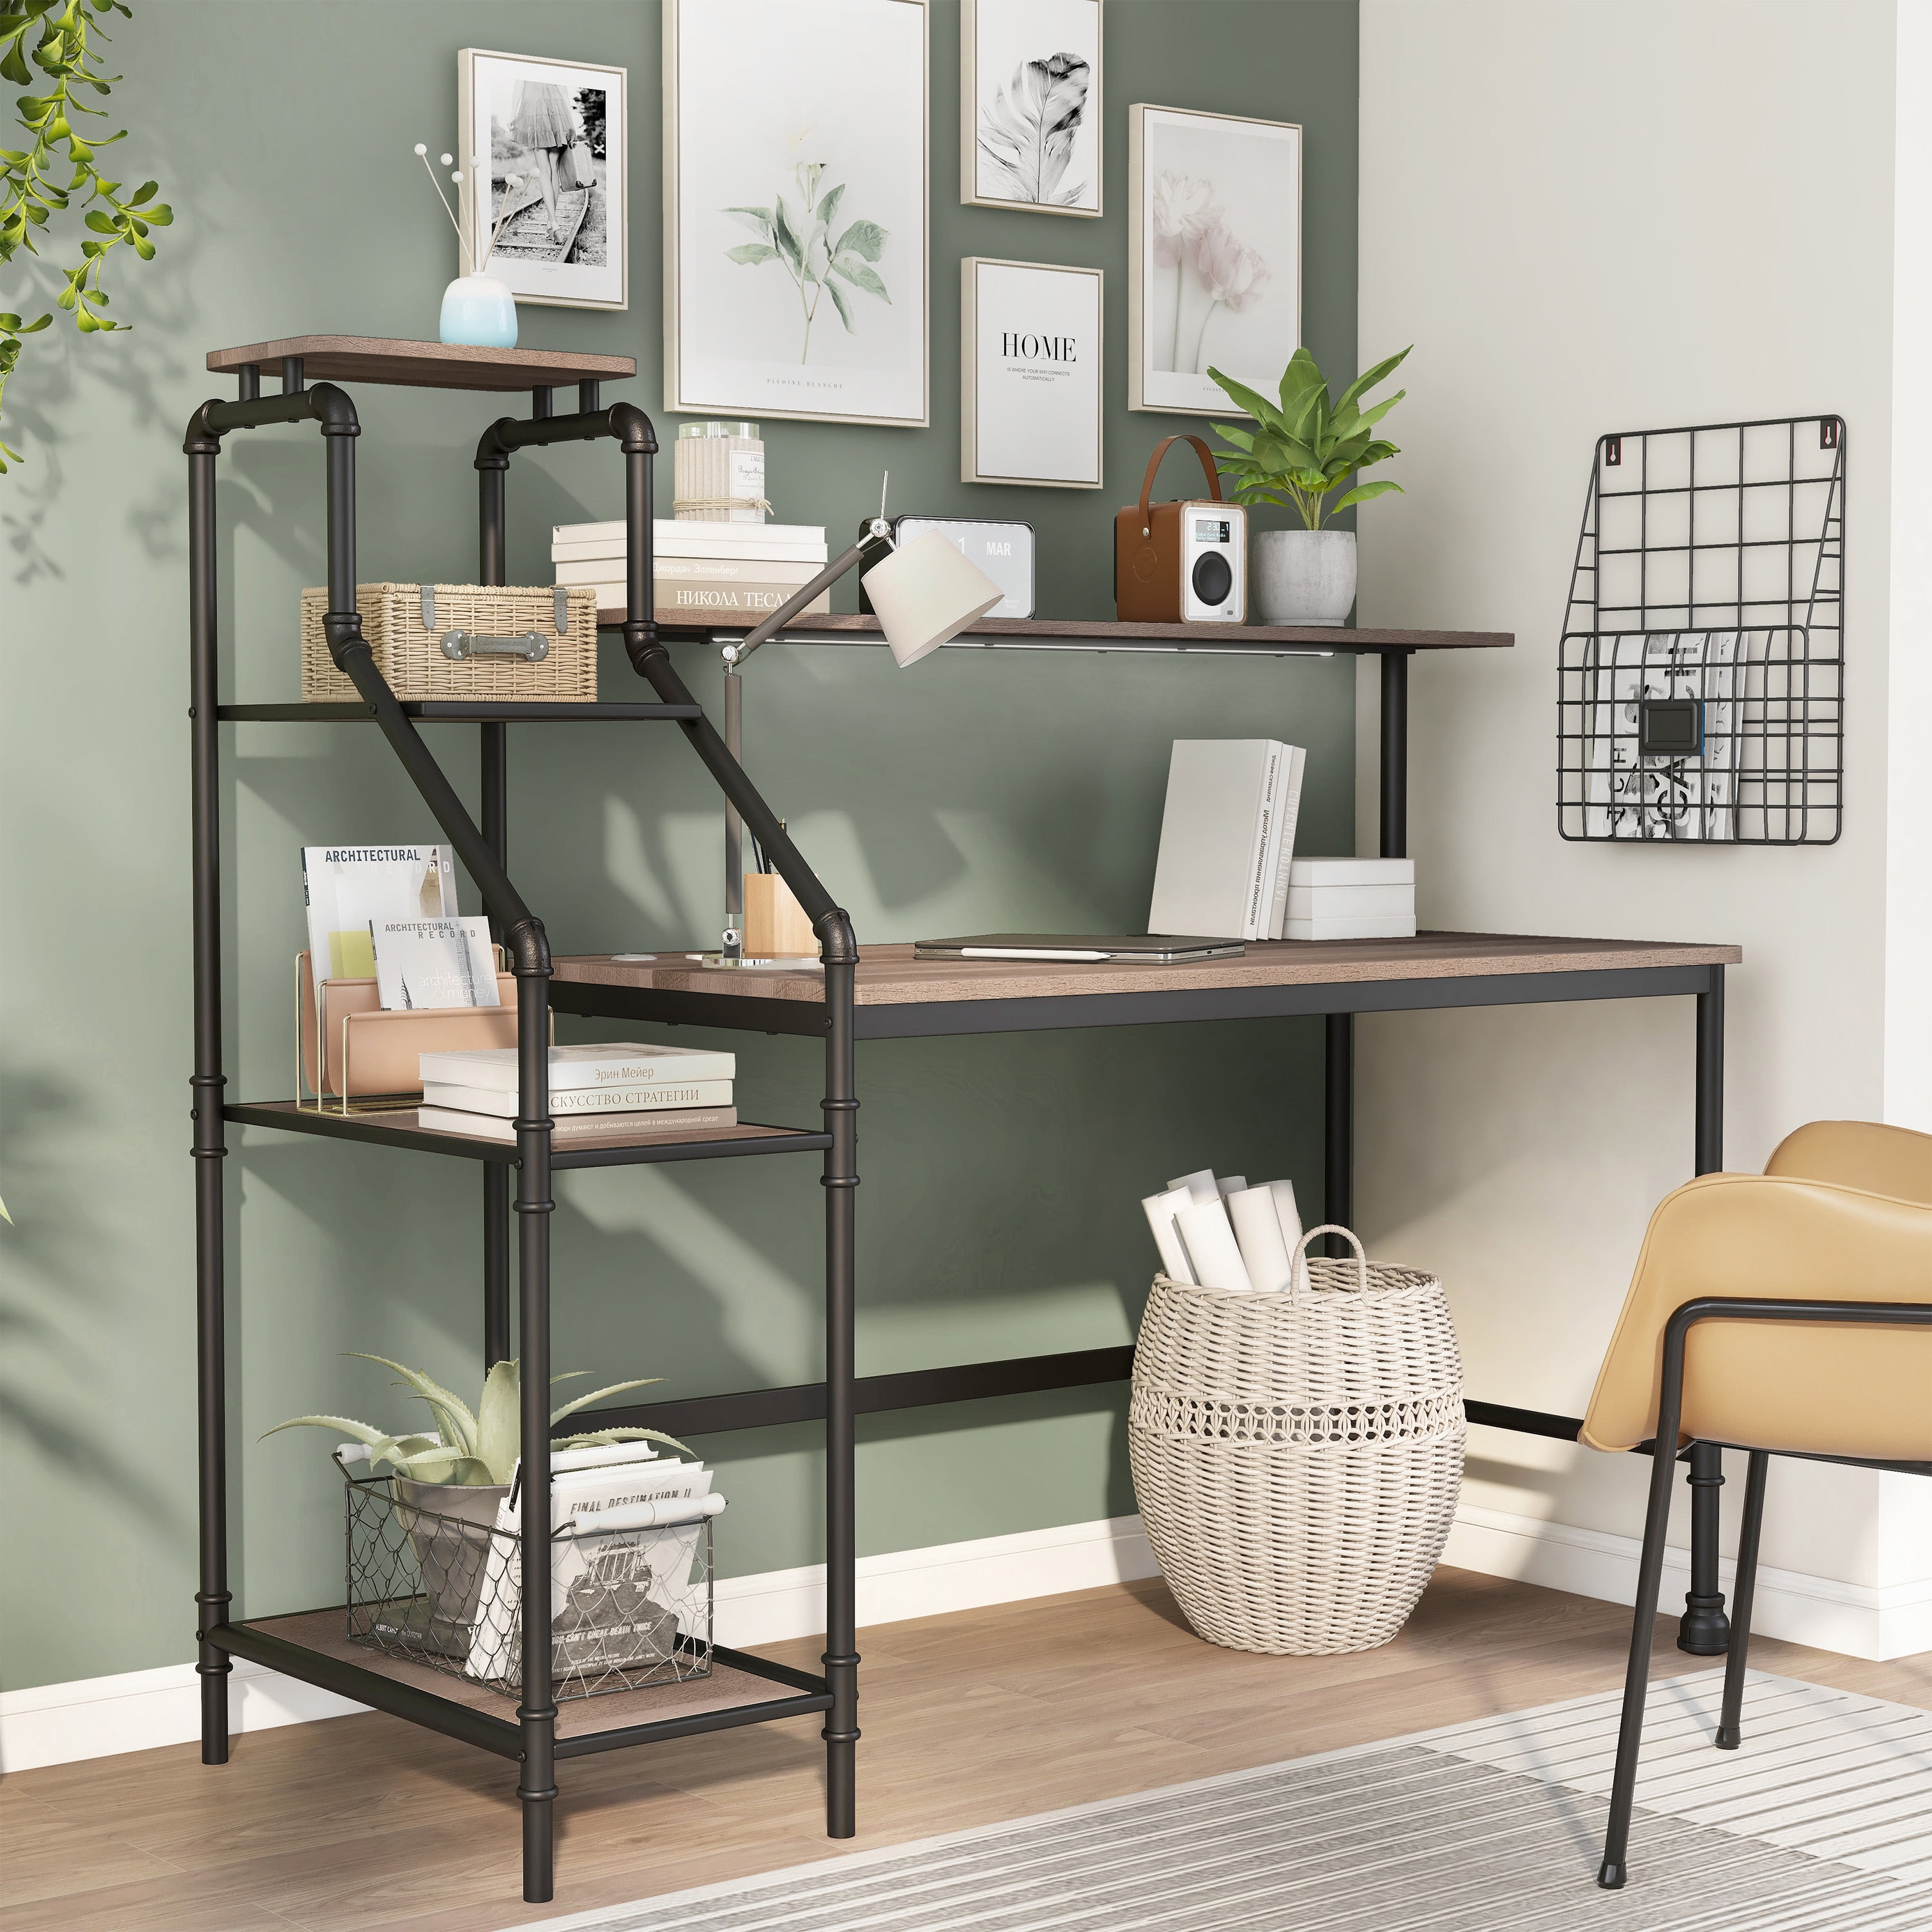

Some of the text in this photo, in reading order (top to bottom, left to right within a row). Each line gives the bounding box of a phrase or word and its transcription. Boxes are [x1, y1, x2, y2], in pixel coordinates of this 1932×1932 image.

[1001, 332, 1076, 361] HOME
[1207, 522, 1220, 531] 2:30
[987, 542, 1011, 556] MAR
[653, 562, 739, 576] Джордан Элленберг
[676, 591, 739, 606] НИКОЛА
[326, 849, 421, 862] ARCHITECTURAL
[385, 922, 455, 932] ARCHITECTURAL
[419, 930, 476, 939] RECORD
[418, 966, 493, 988] architecture
[594, 1066, 654, 1082] Эрин Мейер
[625, 1089, 699, 1104] СТРАТЕГИИ
[657, 1116, 701, 1125] международной
[571, 1488, 692, 1514] FINAL DESTINATION II
[375, 1623, 387, 1632] ALBERT
[633, 1622, 652, 1633] TWICE
